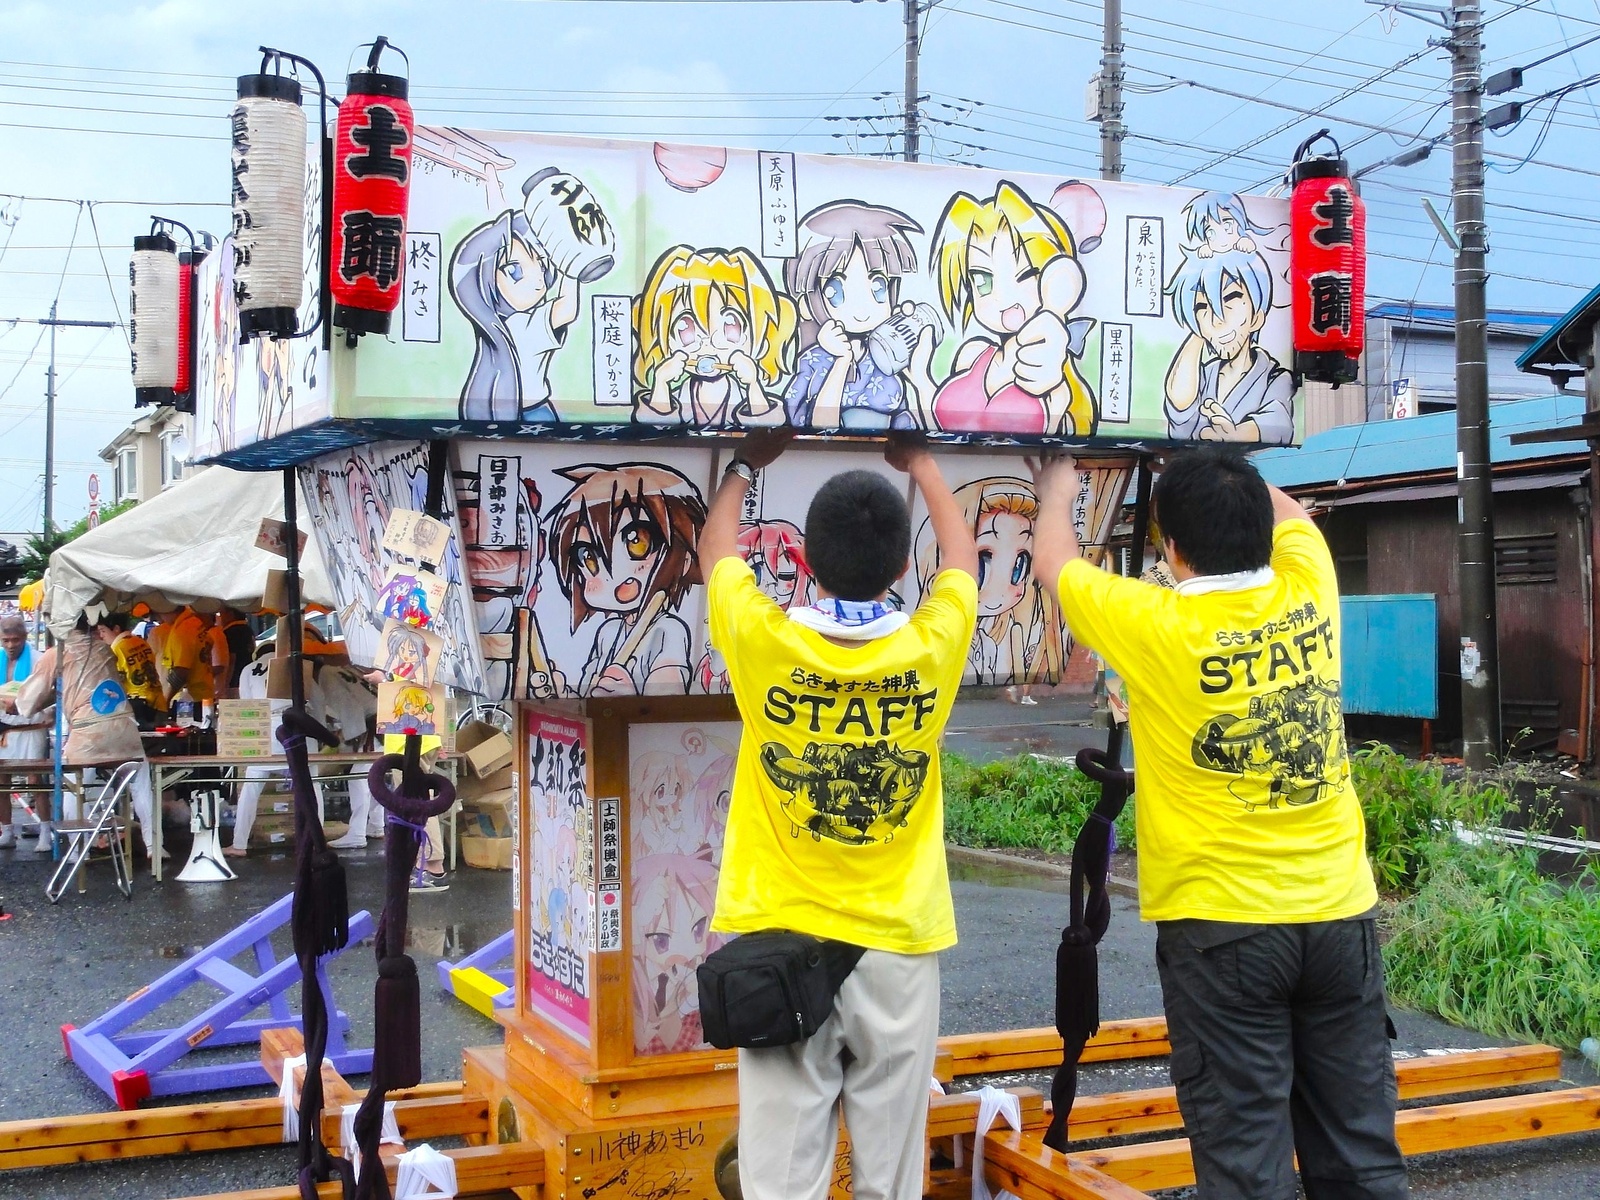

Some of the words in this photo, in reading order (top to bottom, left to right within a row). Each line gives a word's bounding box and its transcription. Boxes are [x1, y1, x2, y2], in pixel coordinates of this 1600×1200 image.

[343, 106, 408, 290] 土師
[769, 157, 787, 247] 天原ふゆき
[1138, 221, 1154, 247] 泉
[409, 240, 436, 316] 柊みき
[600, 301, 625, 398] 桜庭ひかる
[1109, 329, 1124, 416] 黒井ななこ
[488, 459, 508, 544] 日下部みさお
[1200, 616, 1334, 694] STAFF
[764, 686, 938, 736] STAFF
[590, 1121, 705, 1165] 小神あきら
